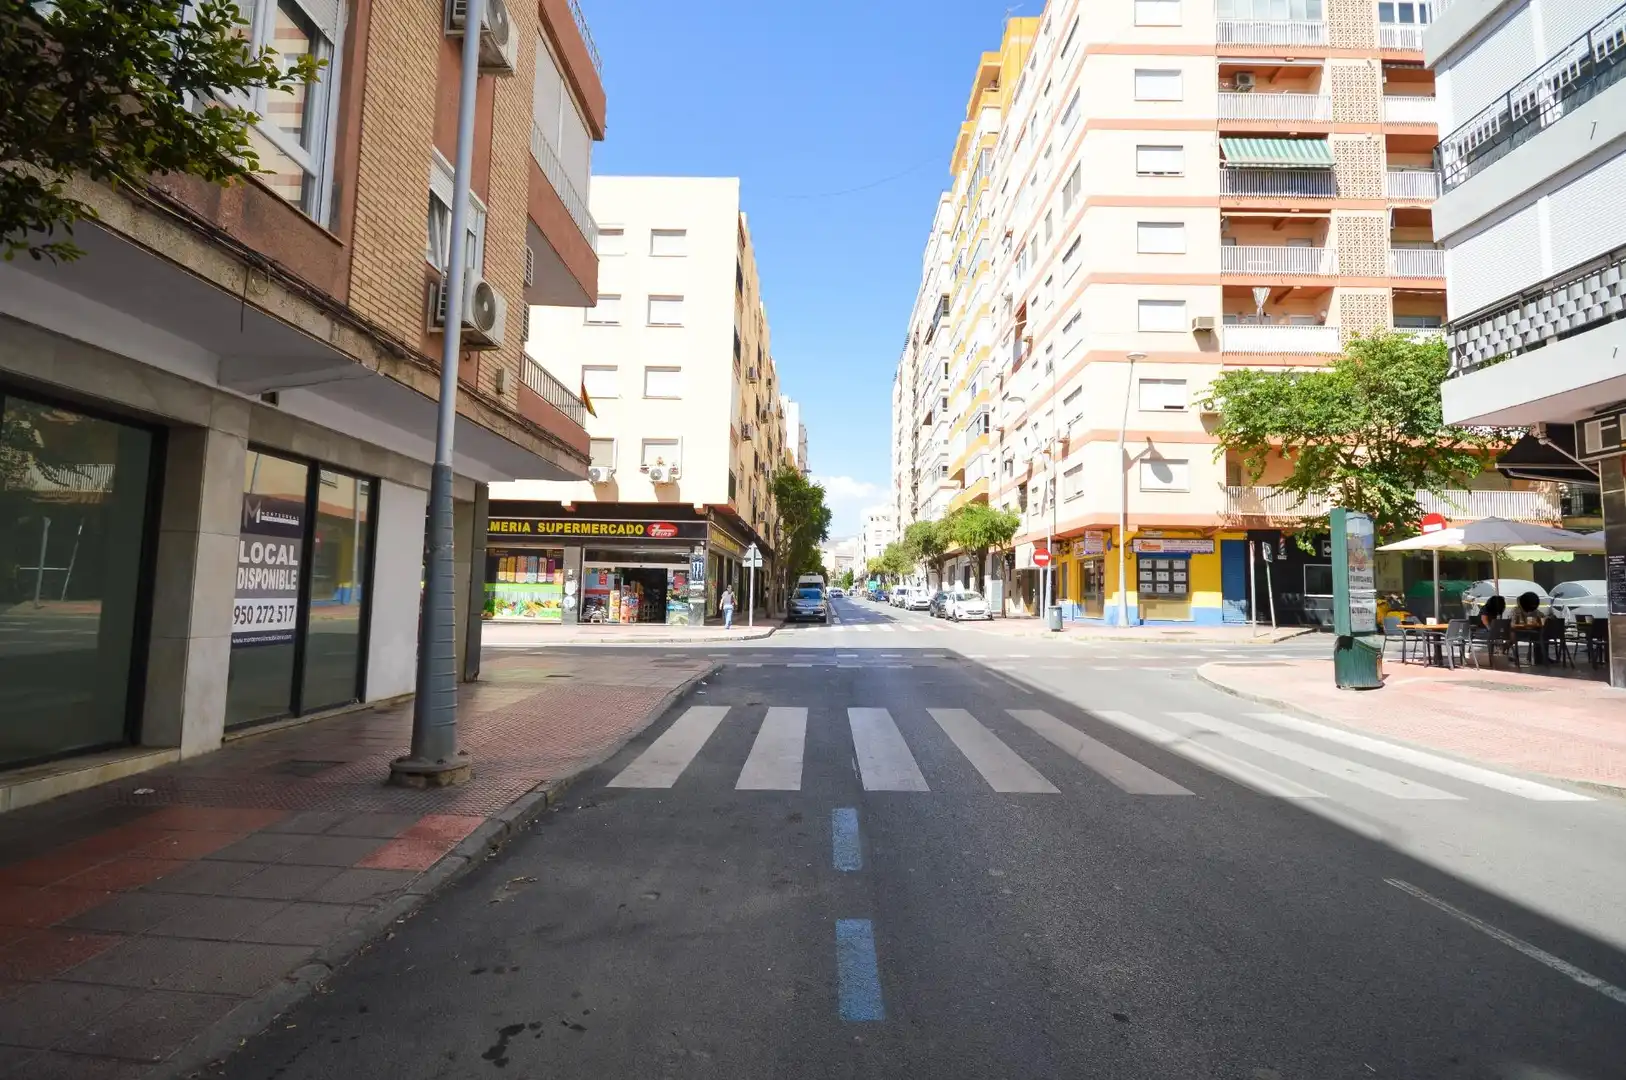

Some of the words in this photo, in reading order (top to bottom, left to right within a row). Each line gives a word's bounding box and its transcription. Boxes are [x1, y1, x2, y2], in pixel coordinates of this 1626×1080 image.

[487, 521, 531, 533] MERIA
[537, 522, 644, 535] SUPERMERCADO
[239, 541, 298, 566] LOCAL
[237, 567, 297, 591] DISPONIBLE
[234, 605, 254, 625] 950
[256, 604, 274, 624] 272
[277, 604, 294, 623] 517
